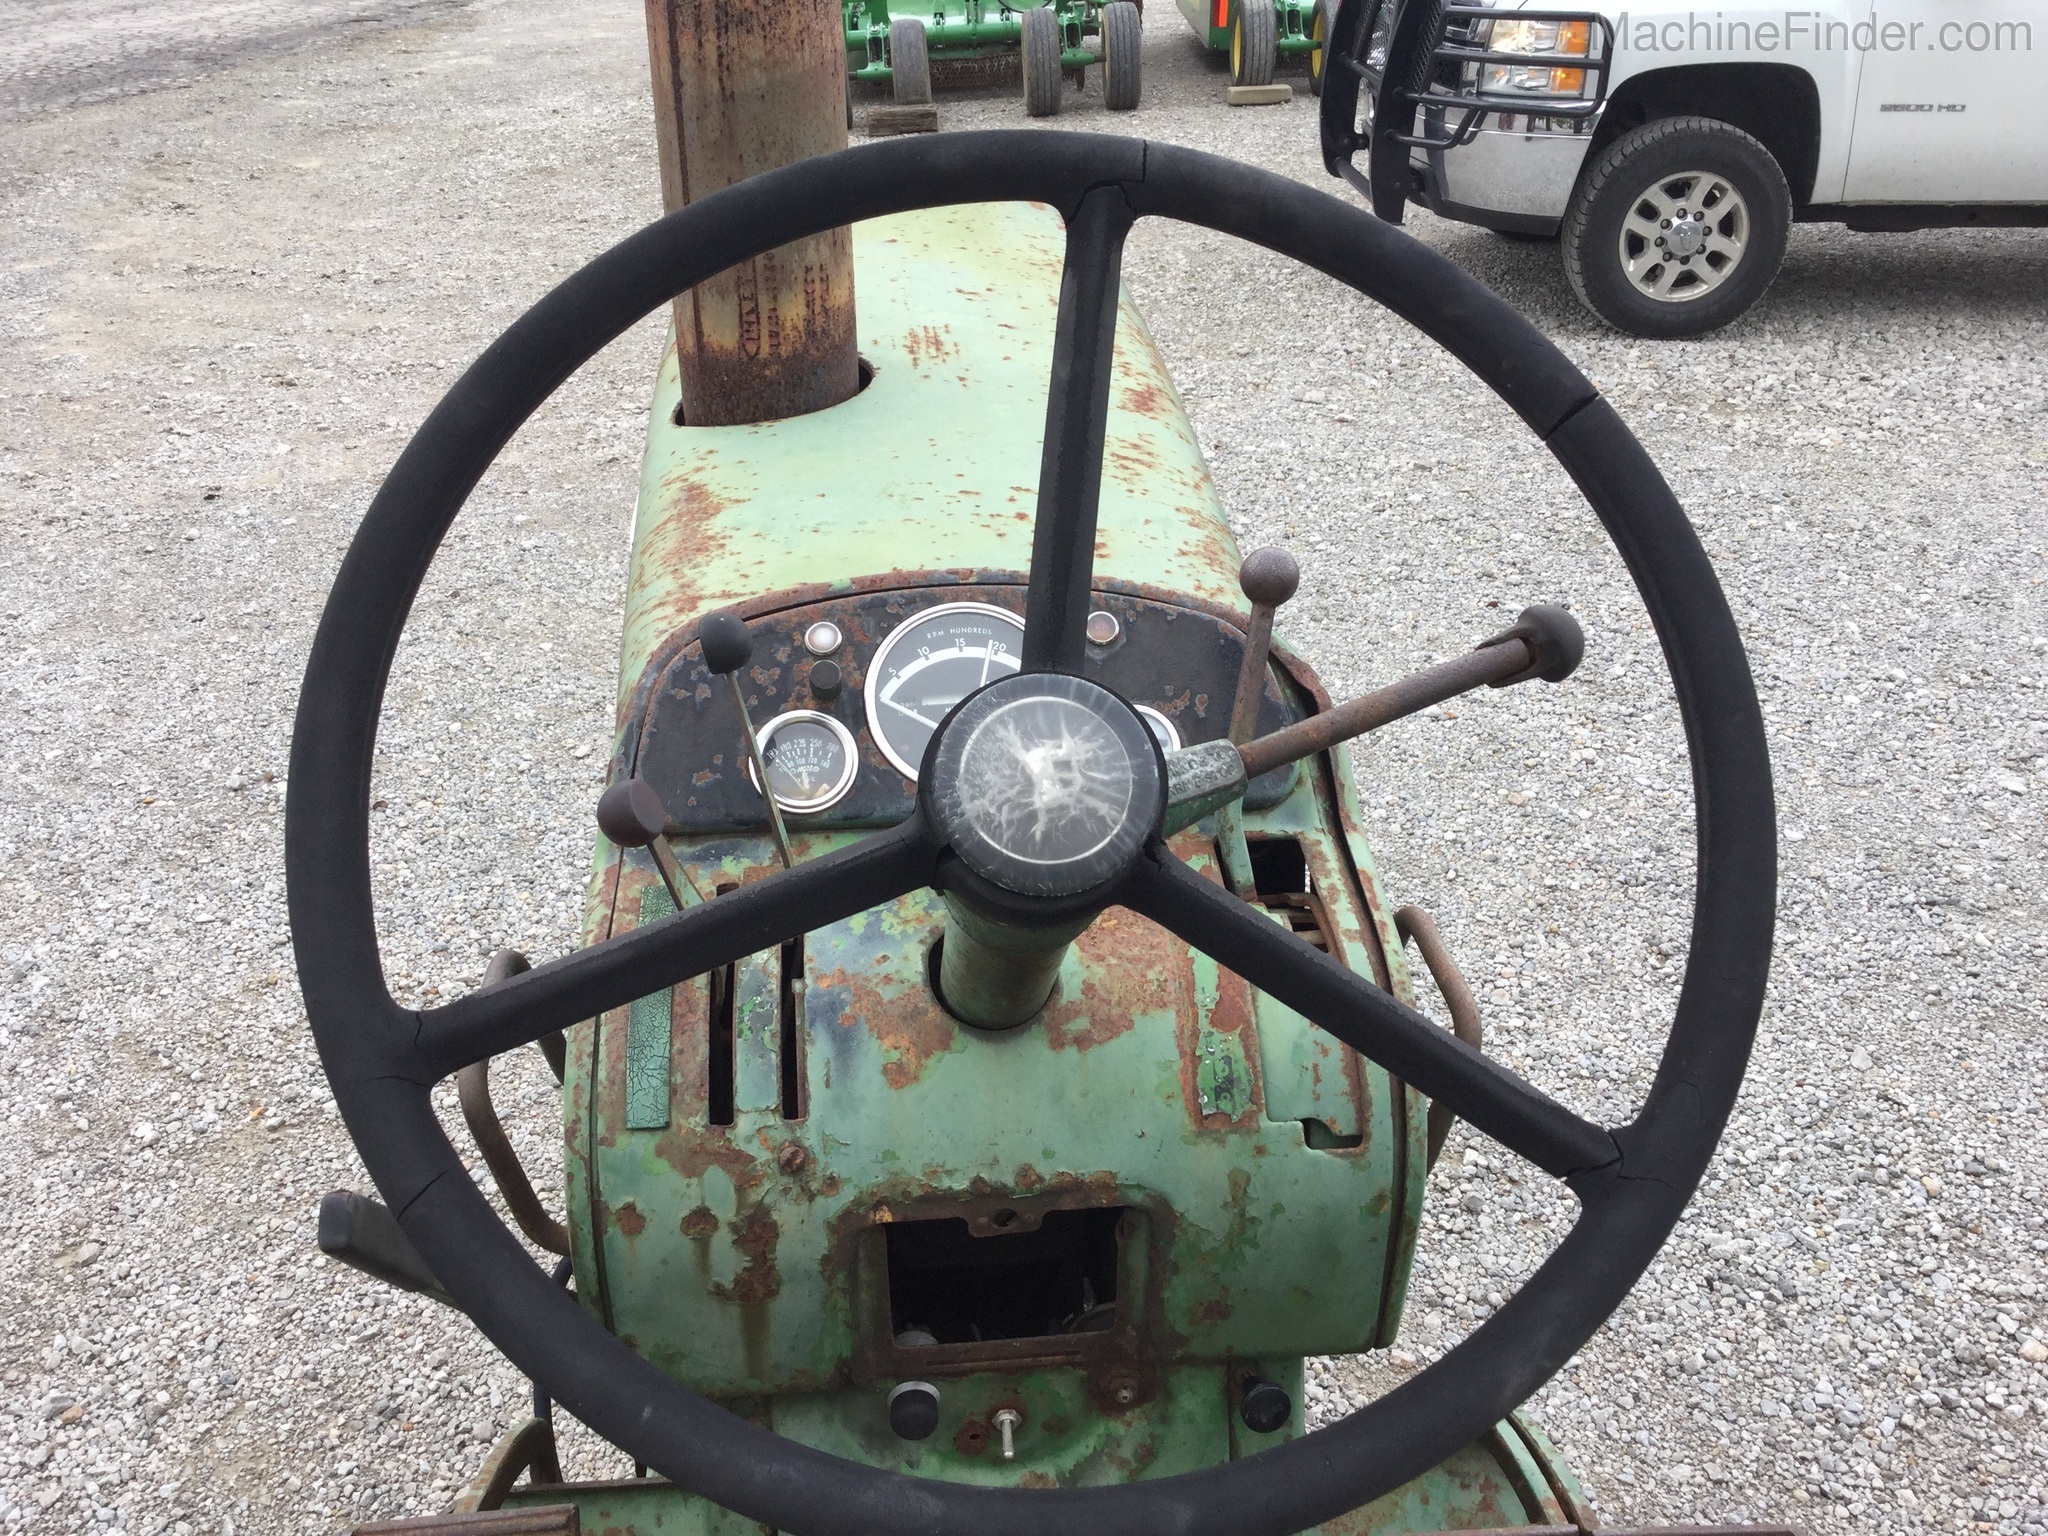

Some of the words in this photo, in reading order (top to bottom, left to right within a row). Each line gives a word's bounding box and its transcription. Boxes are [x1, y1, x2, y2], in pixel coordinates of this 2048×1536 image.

[1937, 103, 1966, 112] HD
[927, 630, 945, 639] RPM
[950, 626, 992, 636] HUNDREDS
[955, 638, 966, 647] 15
[992, 641, 1007, 652] 20
[917, 646, 930, 657] 10
[888, 667, 897, 676] 5
